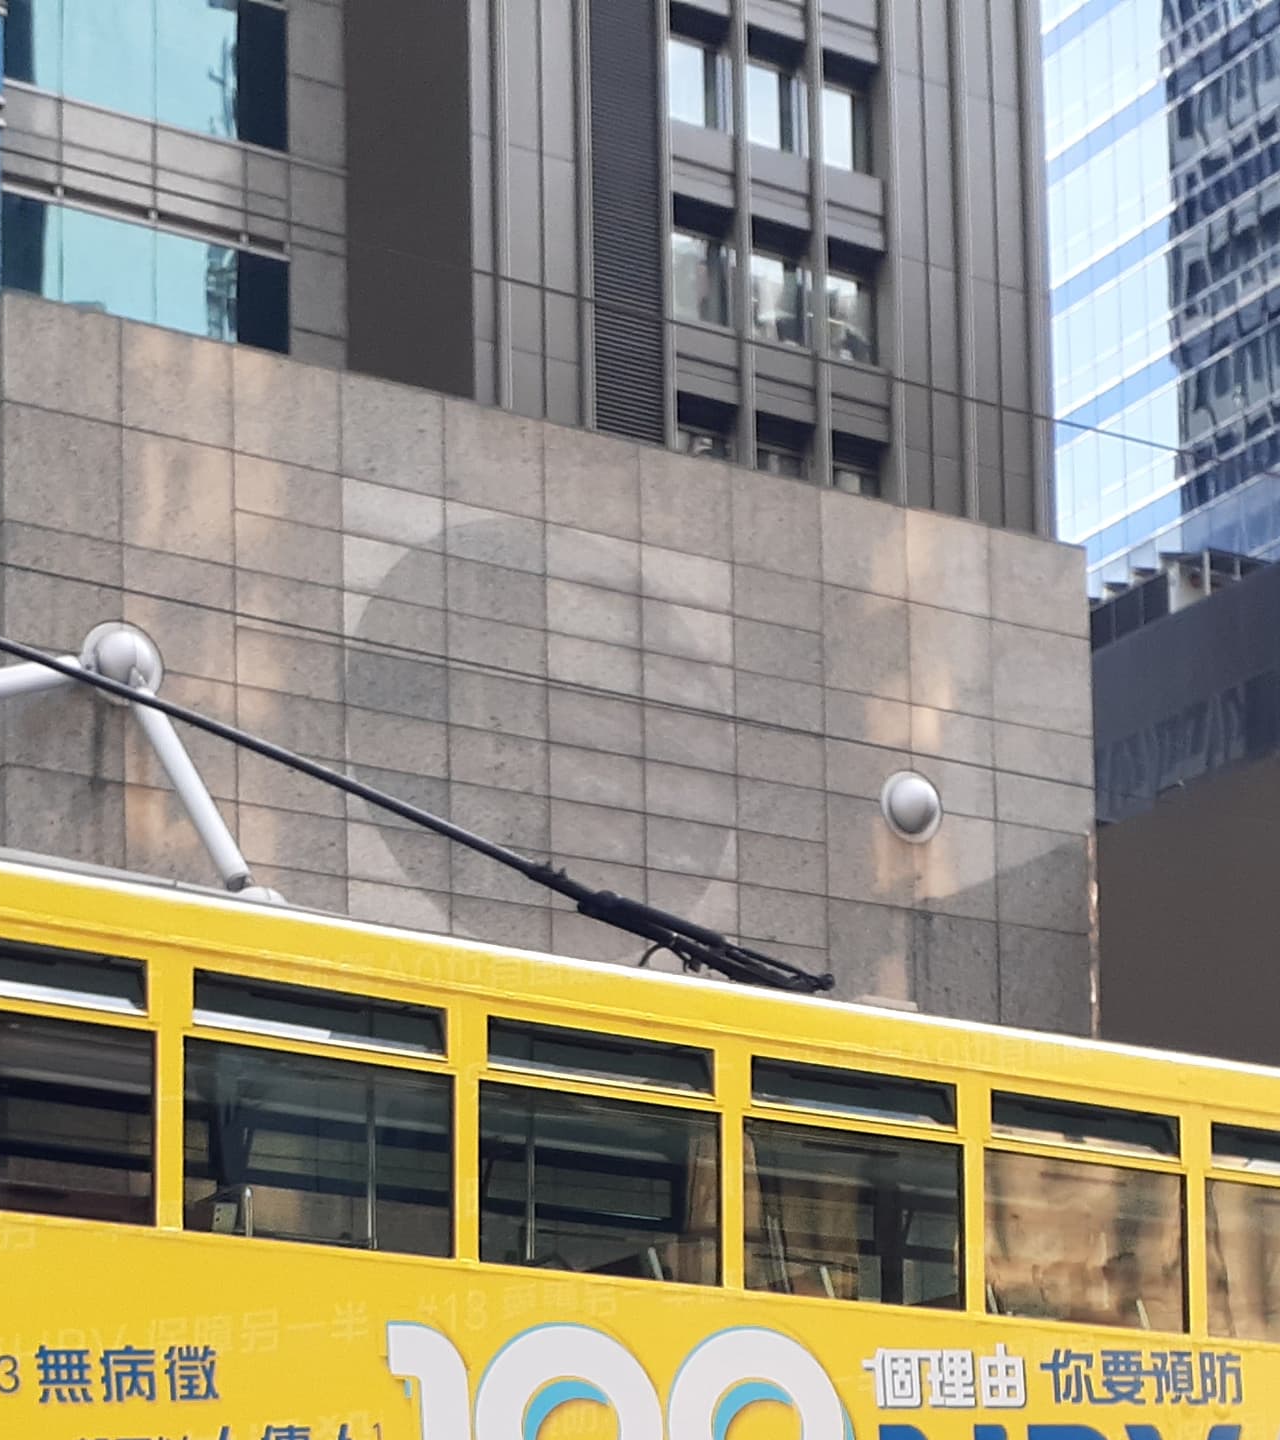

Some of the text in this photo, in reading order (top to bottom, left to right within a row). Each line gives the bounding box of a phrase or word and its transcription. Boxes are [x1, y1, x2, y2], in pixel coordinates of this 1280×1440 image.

[34, 1344, 221, 1405] 無病徵
[863, 1343, 1244, 1409] 個理由 你要預防
